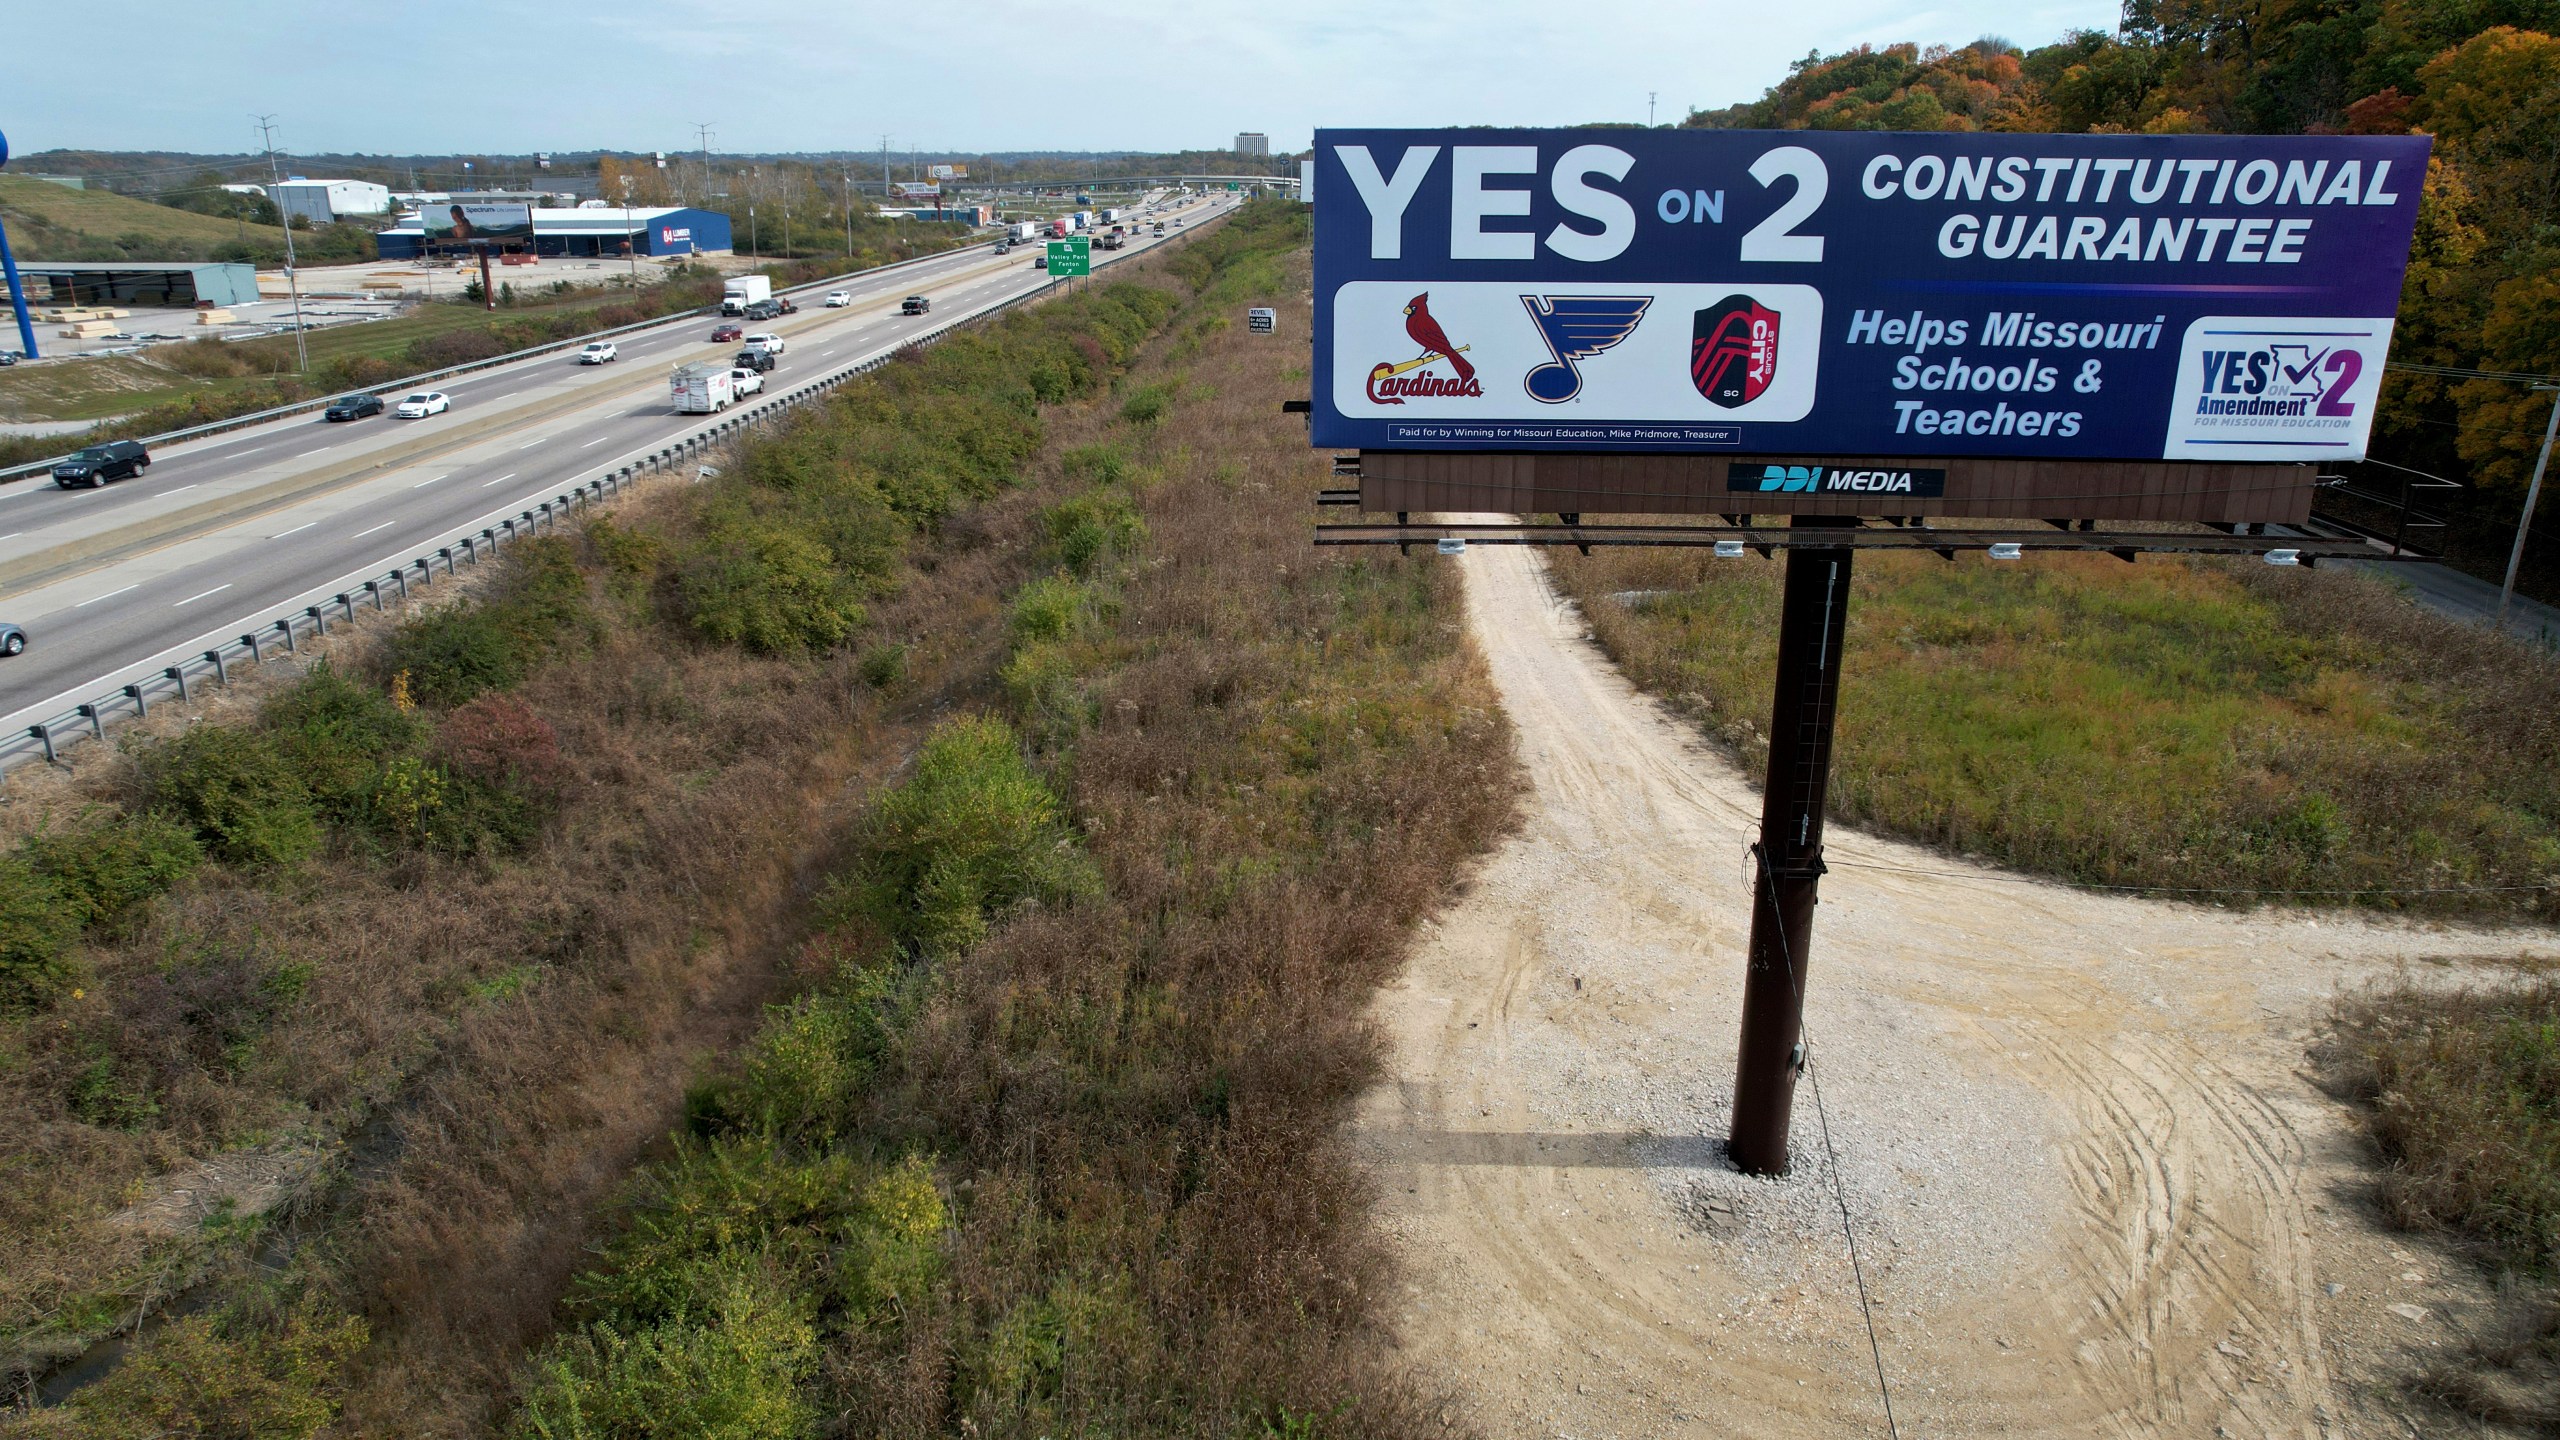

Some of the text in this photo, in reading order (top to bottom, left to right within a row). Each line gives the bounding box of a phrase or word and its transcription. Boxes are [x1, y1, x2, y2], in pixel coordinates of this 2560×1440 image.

[1861, 154, 2399, 205] CONSTITUTIONAL
[1333, 144, 1829, 263] YES ON 2
[663, 230, 672, 242] 84
[1937, 214, 2313, 263] GUARANTEE
[1750, 319, 1768, 384] CITY
[1765, 330, 1775, 375] ST LOUIS
[1846, 309, 2166, 353] Helps Missouri
[1366, 362, 1484, 405] Cardinals
[1892, 355, 2103, 393] Schools &
[2202, 349, 2363, 417] YES ON 2
[1893, 401, 2083, 437] Teachers
[2194, 418, 2351, 428] FOR MISSOURI EDUCATION
[2196, 396, 2308, 416] Amendment
[1399, 428, 1729, 440] Paid for by Winning for Missouri Education, Mike Pridmore, Treasurer
[1759, 465, 1912, 492] DDI MEDIA
